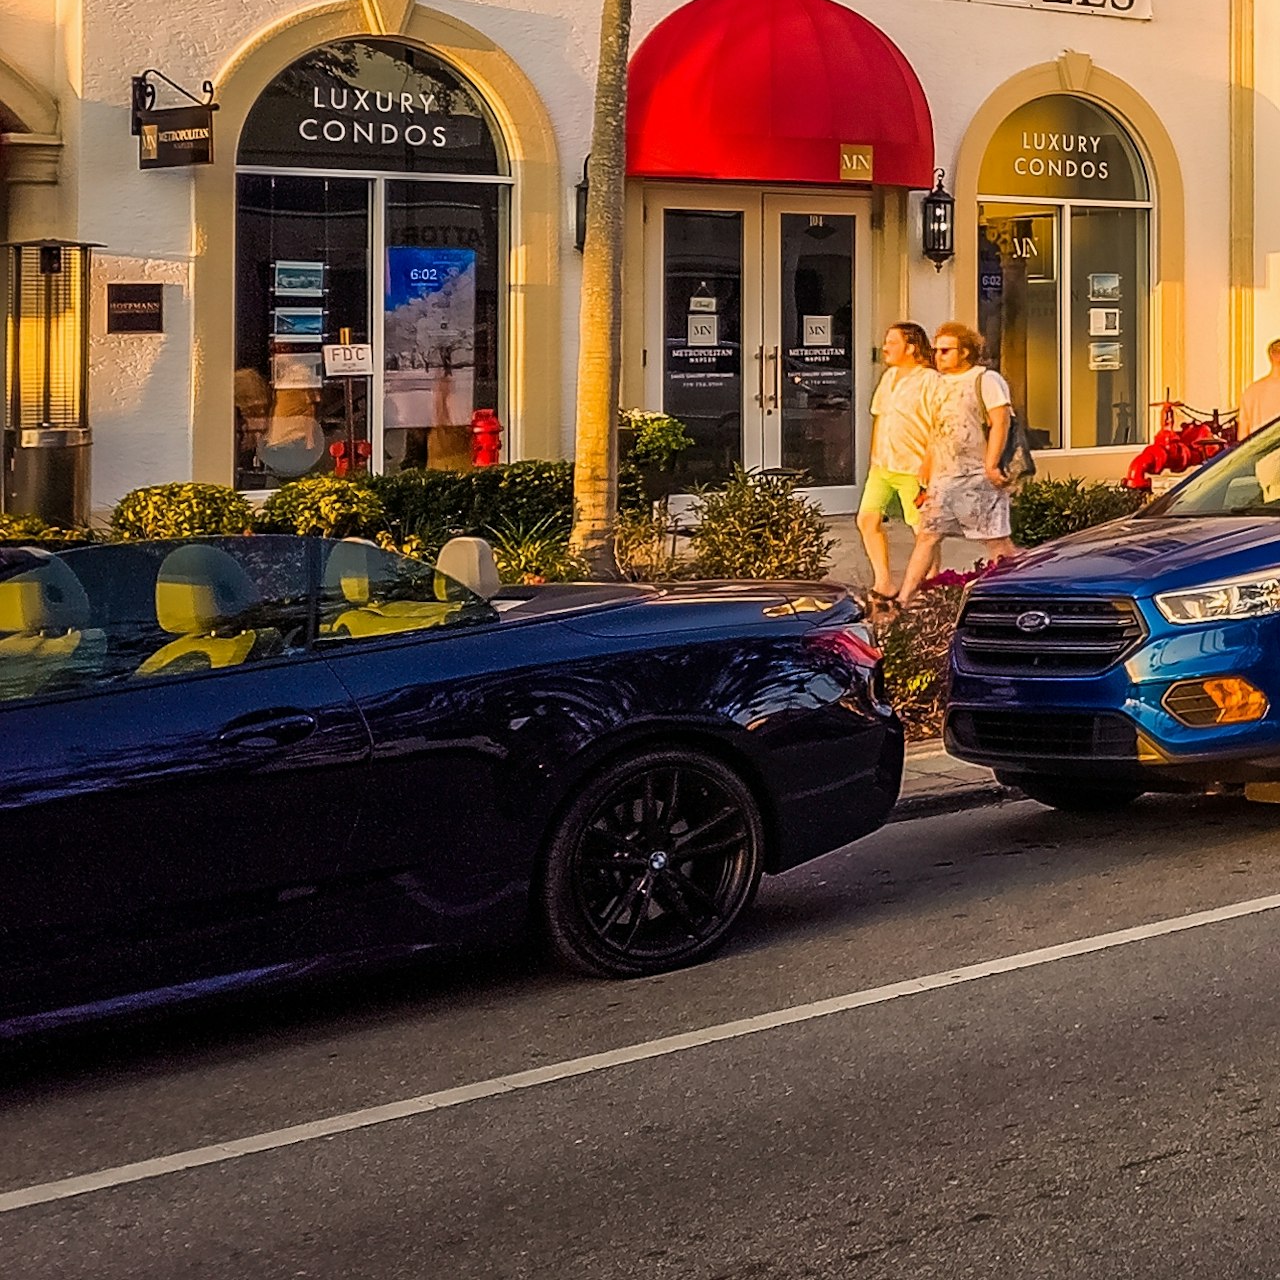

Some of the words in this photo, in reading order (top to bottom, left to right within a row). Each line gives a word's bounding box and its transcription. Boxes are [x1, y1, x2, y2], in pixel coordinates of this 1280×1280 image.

[313, 86, 435, 115] LUXURY
[158, 128, 209, 142] METROPOLITAN
[298, 118, 447, 148] CONDOS
[1022, 131, 1101, 154] LUXURY
[841, 153, 870, 171] MN
[1014, 157, 1109, 180] CONDOS
[1012, 237, 1039, 259] MN
[410, 268, 438, 281] 6:02
[981, 275, 1002, 287] 6:02
[693, 325, 712, 336] MN
[808, 325, 826, 336] MN
[331, 346, 365, 362] FDC
[671, 349, 733, 357] METROPOLITAN
[788, 348, 845, 357] METROPOLITAN
